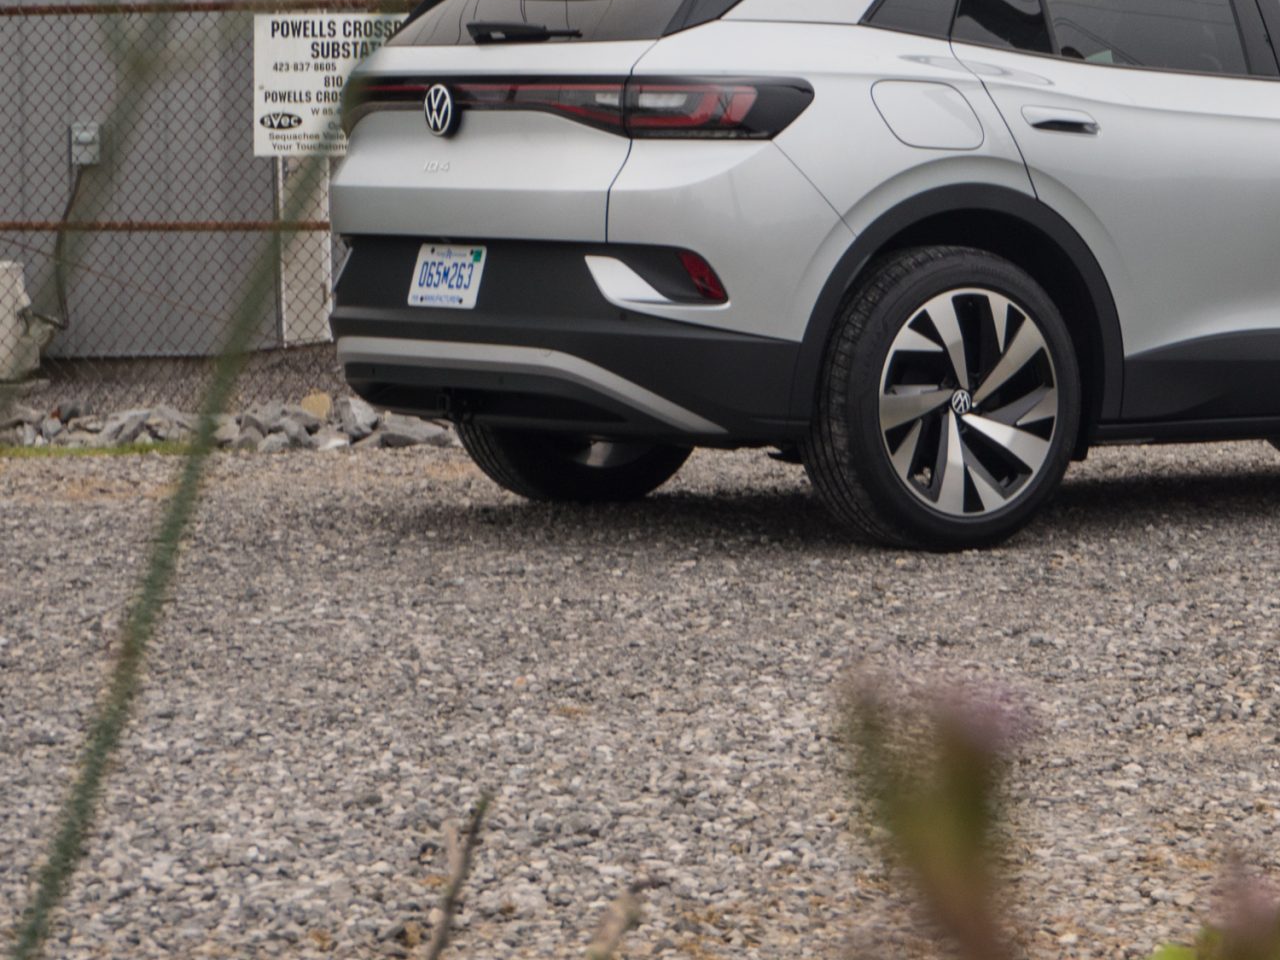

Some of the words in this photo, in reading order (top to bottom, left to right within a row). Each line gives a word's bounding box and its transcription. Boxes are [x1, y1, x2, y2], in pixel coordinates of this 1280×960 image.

[271, 20, 337, 38] POWELLS
[311, 41, 382, 59] SUBSTAT
[324, 76, 343, 87] 810
[264, 91, 311, 103] POWELLS
[272, 143, 292, 151] Your
